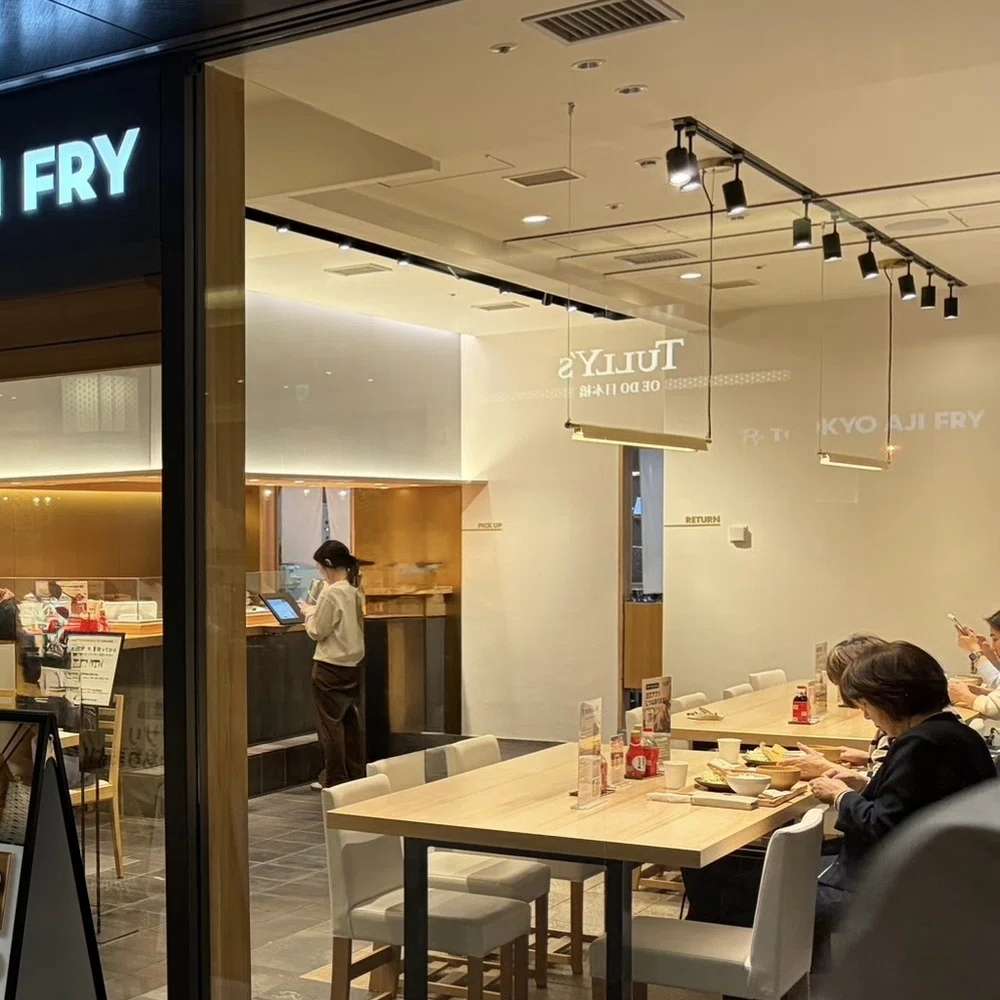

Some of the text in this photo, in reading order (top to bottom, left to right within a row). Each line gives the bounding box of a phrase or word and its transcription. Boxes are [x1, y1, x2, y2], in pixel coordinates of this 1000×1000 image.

[23, 126, 141, 211] FRY
[884, 412, 925, 433] AJI
[934, 409, 985, 431] FRY
[685, 516, 721, 524] RETURN
